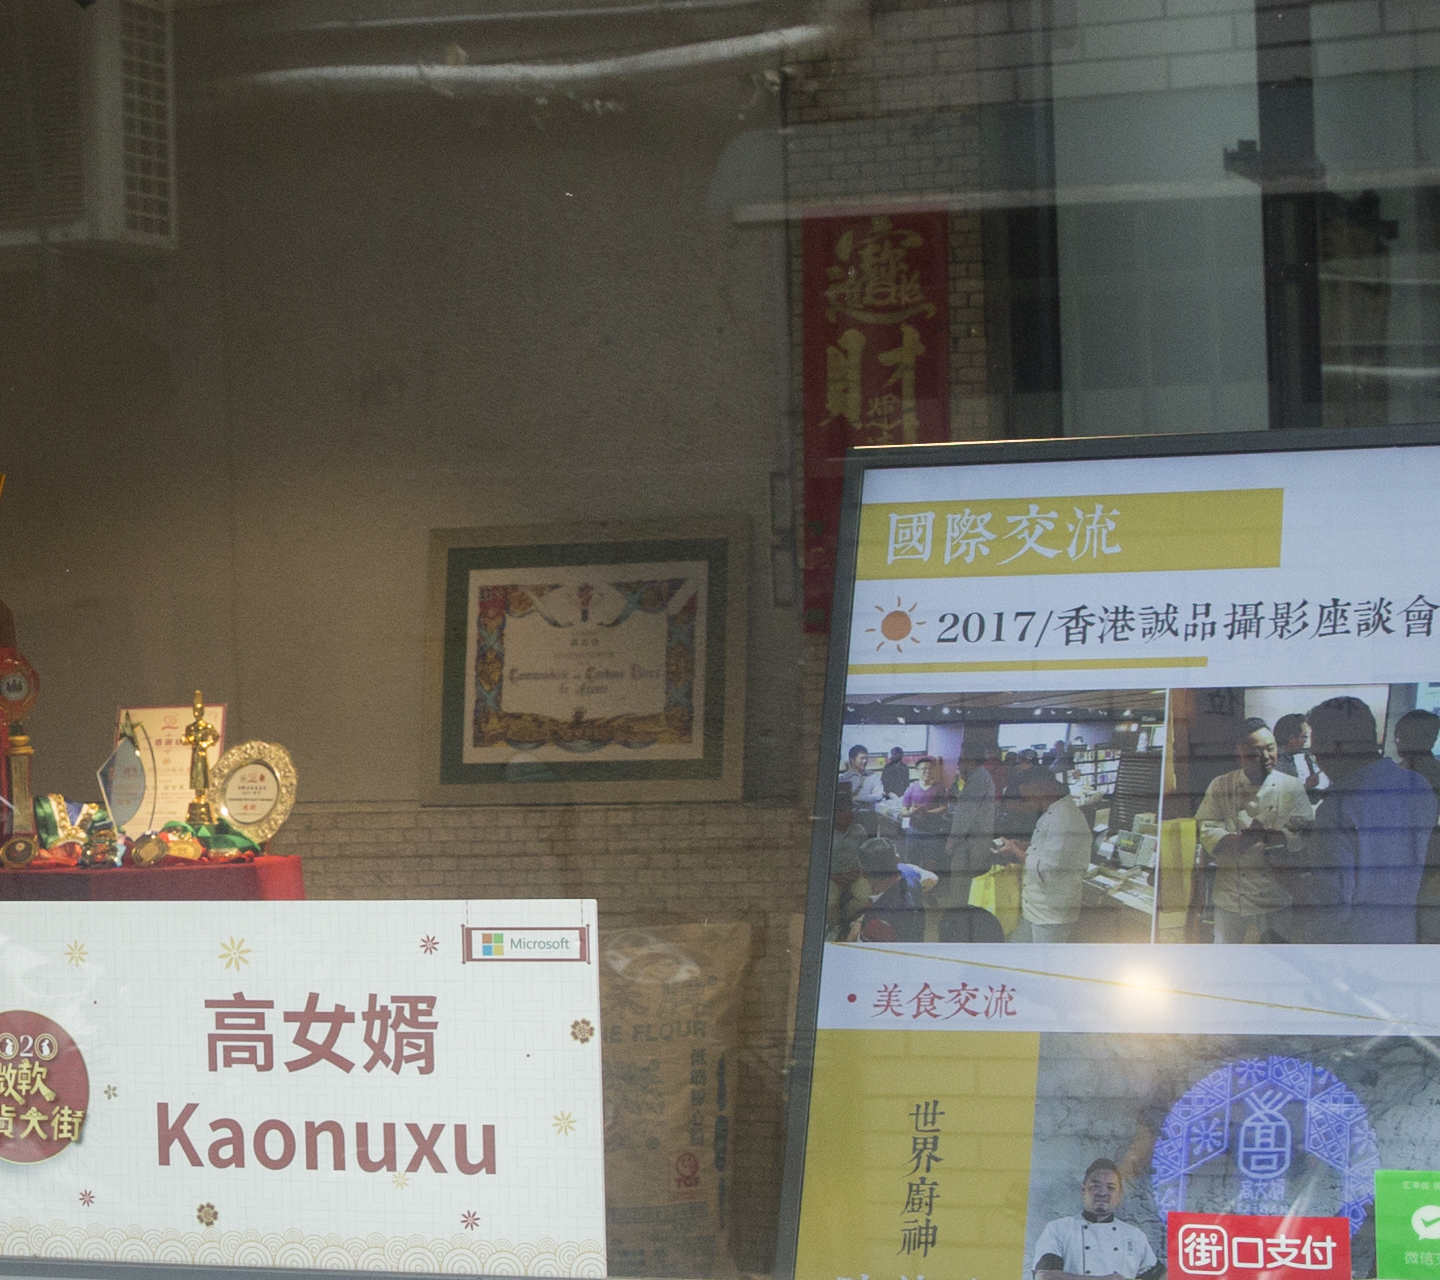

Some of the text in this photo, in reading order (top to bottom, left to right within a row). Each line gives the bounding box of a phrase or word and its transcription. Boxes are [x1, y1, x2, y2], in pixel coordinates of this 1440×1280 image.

[886, 504, 1122, 567] 國際交流
[510, 937, 570, 950] Microsoft
[871, 981, 1018, 1019] 美食交流
[204, 991, 439, 1076] 高女婿
[156, 1101, 497, 1176] Kaonuxu
[897, 1099, 945, 1259] 世界廚神
[1183, 1231, 1337, 1271] 街口支付
